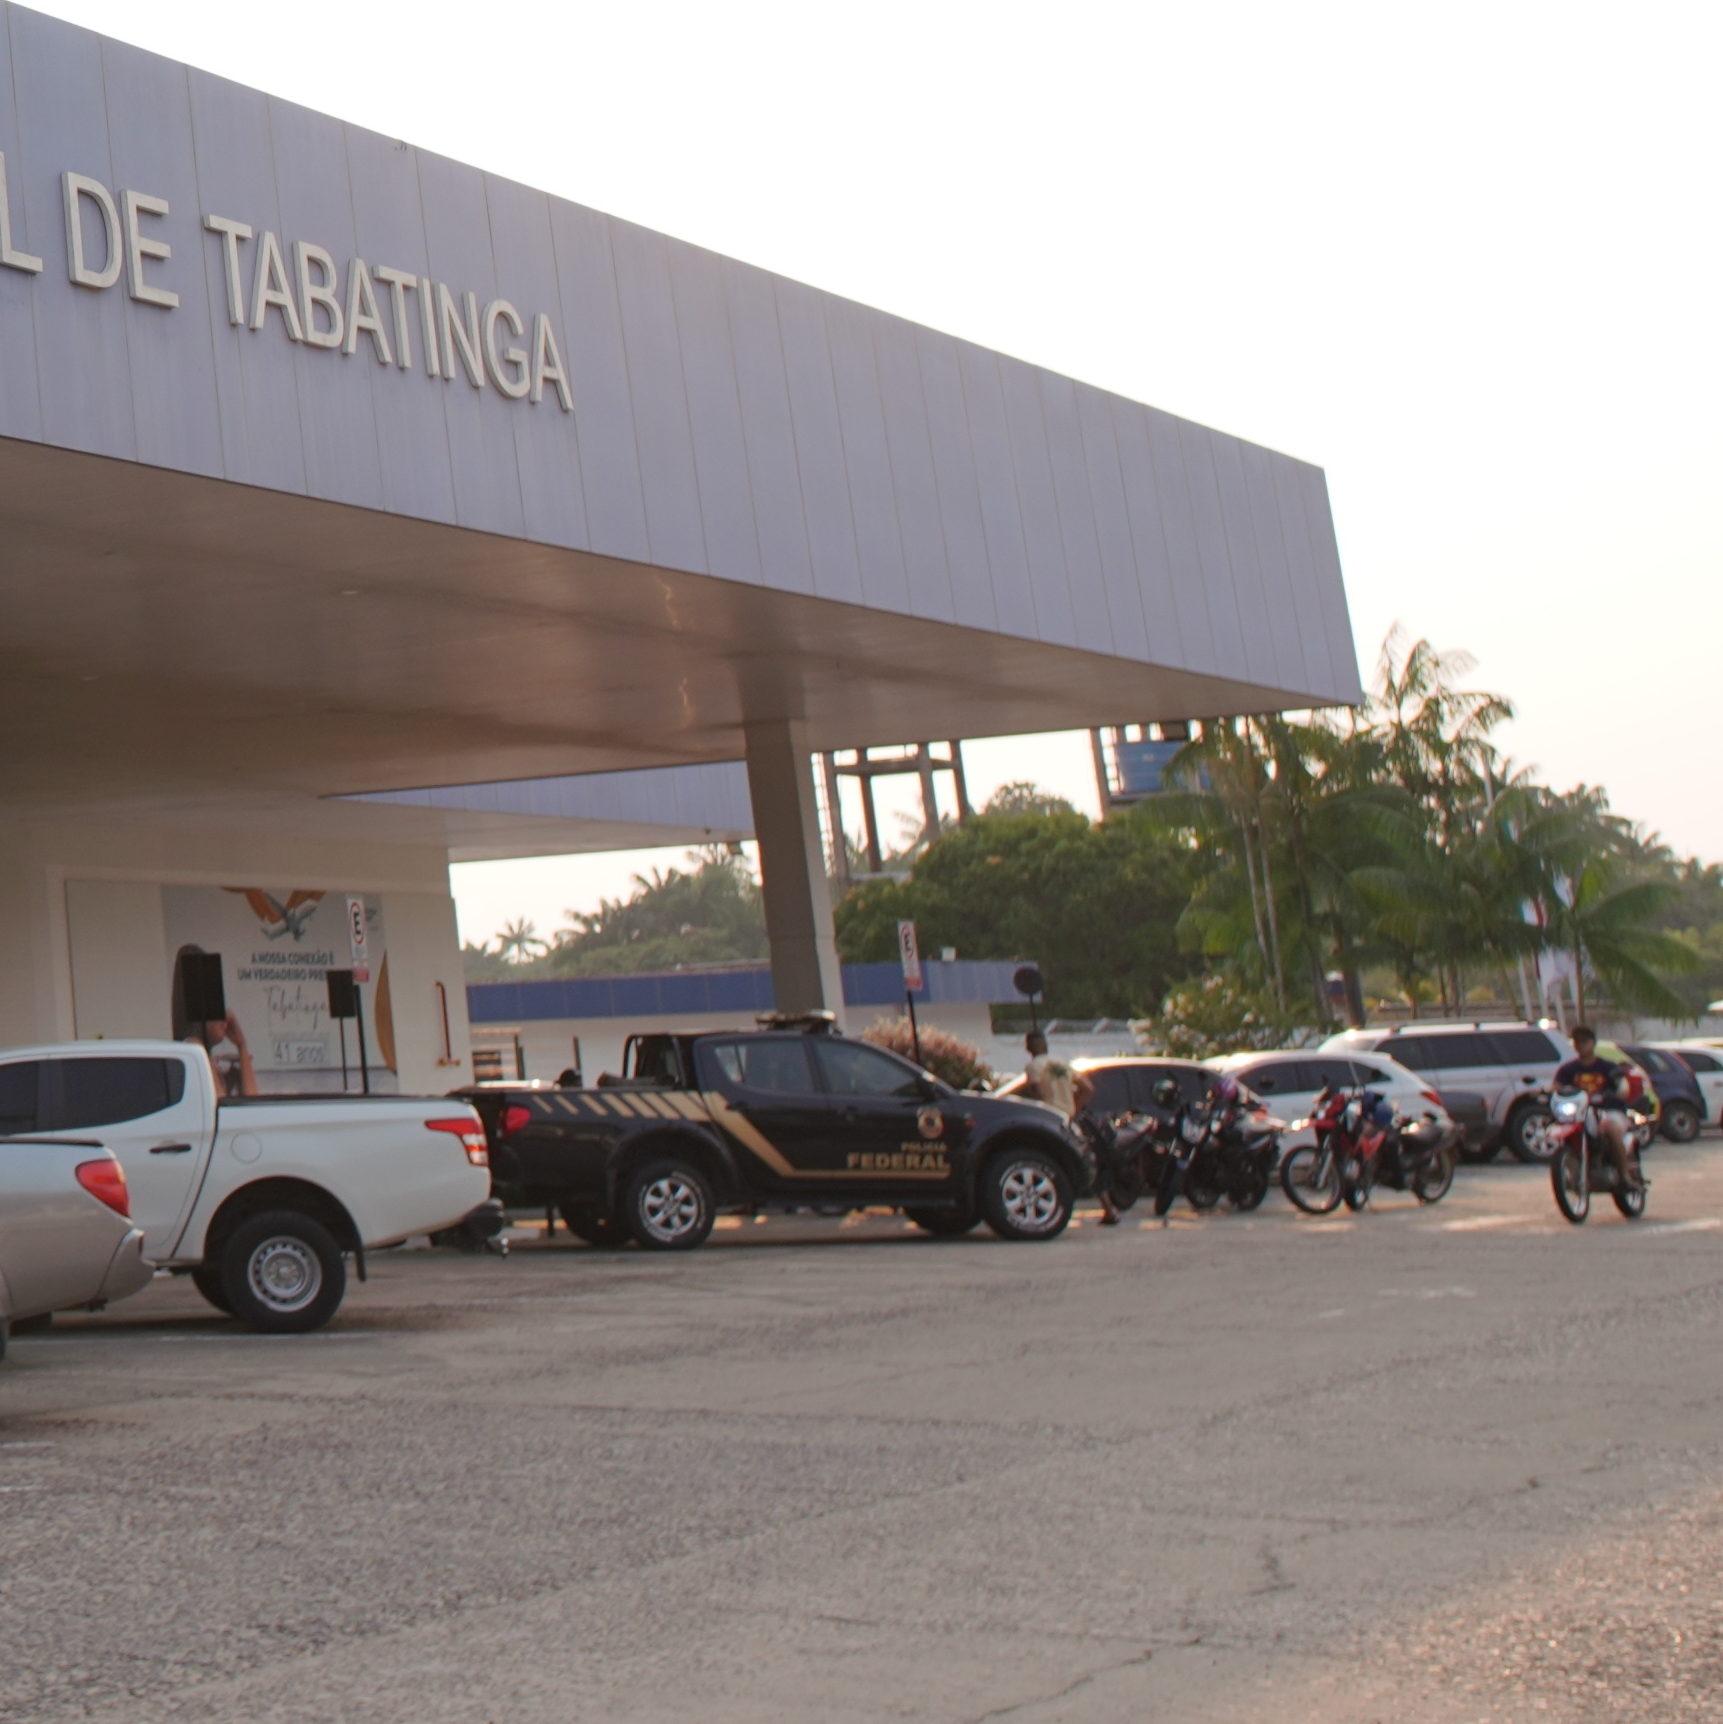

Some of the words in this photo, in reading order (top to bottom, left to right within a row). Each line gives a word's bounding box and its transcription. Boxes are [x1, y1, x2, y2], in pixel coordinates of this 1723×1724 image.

[63, 171, 179, 308] DE
[203, 213, 575, 412] TABATINGA
[847, 1152, 946, 1170] FEDERAL
